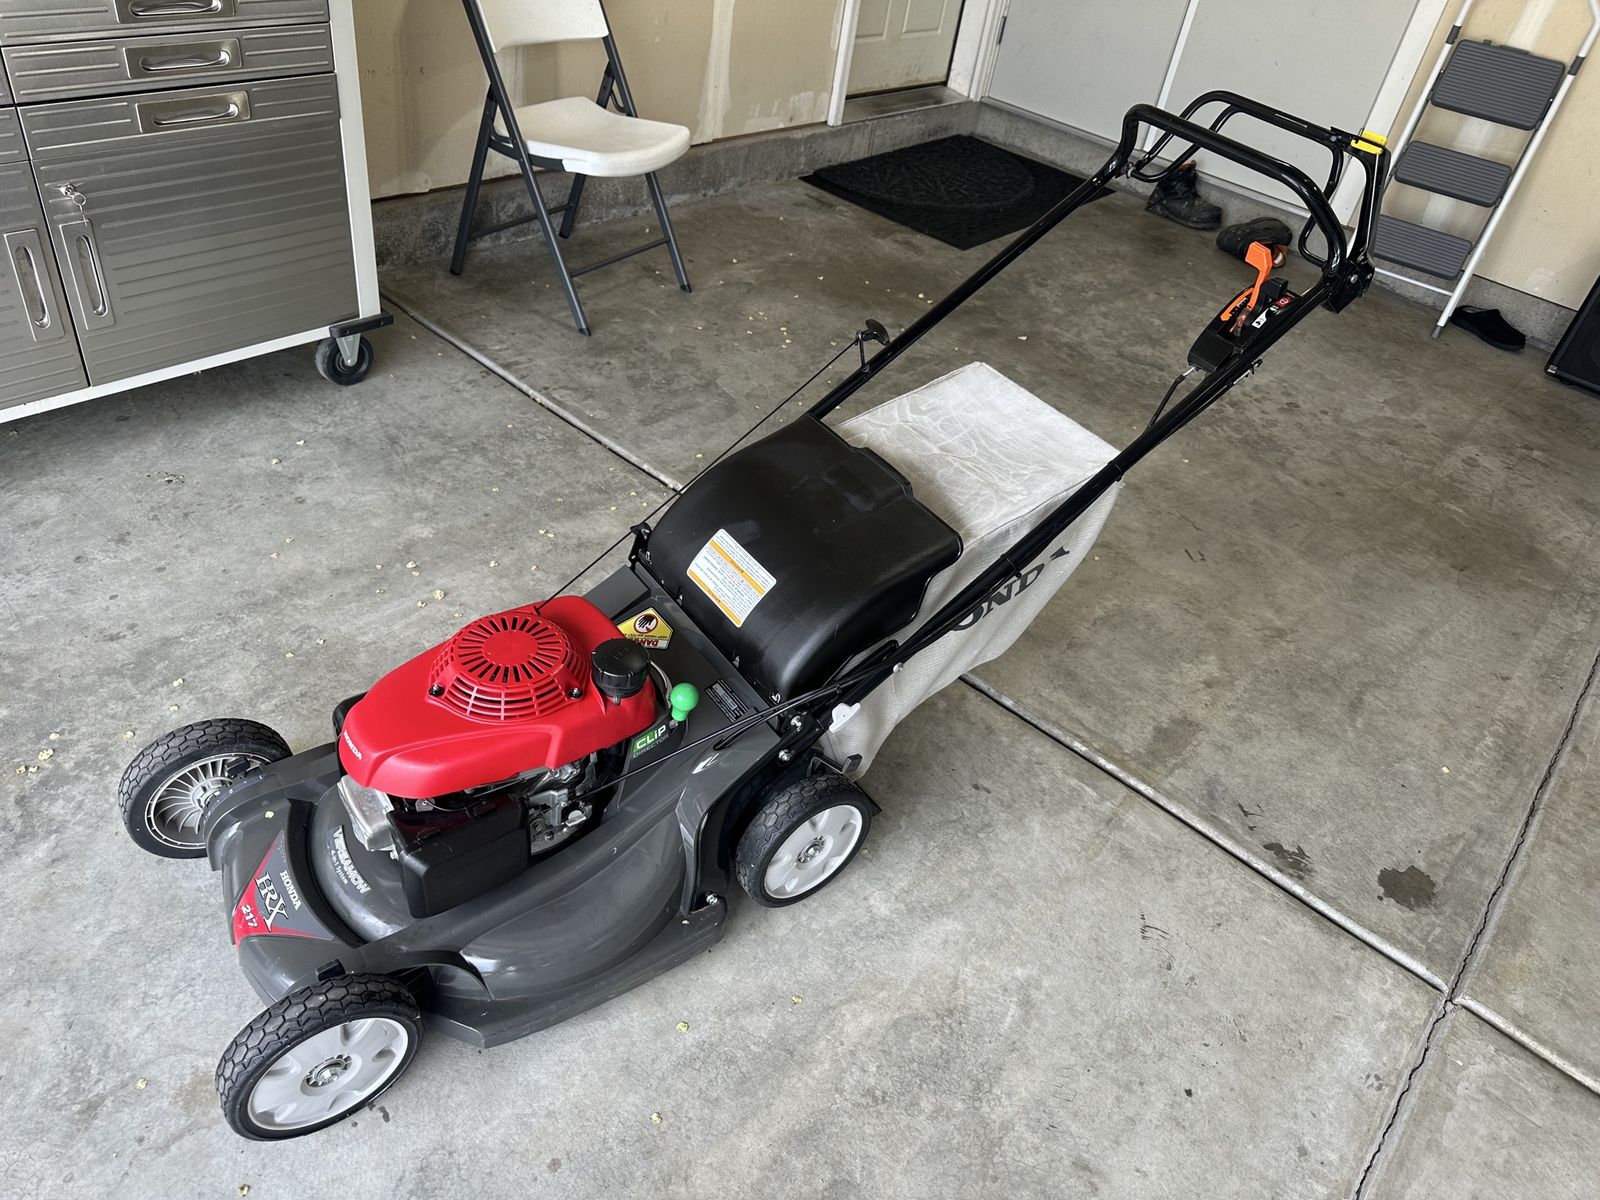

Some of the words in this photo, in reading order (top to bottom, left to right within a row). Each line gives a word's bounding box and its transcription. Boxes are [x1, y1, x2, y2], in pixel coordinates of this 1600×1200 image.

[952, 546, 1071, 632] OND
[343, 729, 363, 760] HONDA
[632, 733, 670, 759] DIRECTOR
[333, 825, 371, 894] VERSAMOW
[254, 871, 289, 933] HRX
[280, 869, 302, 911] HONDA
[241, 904, 258, 928] 217
